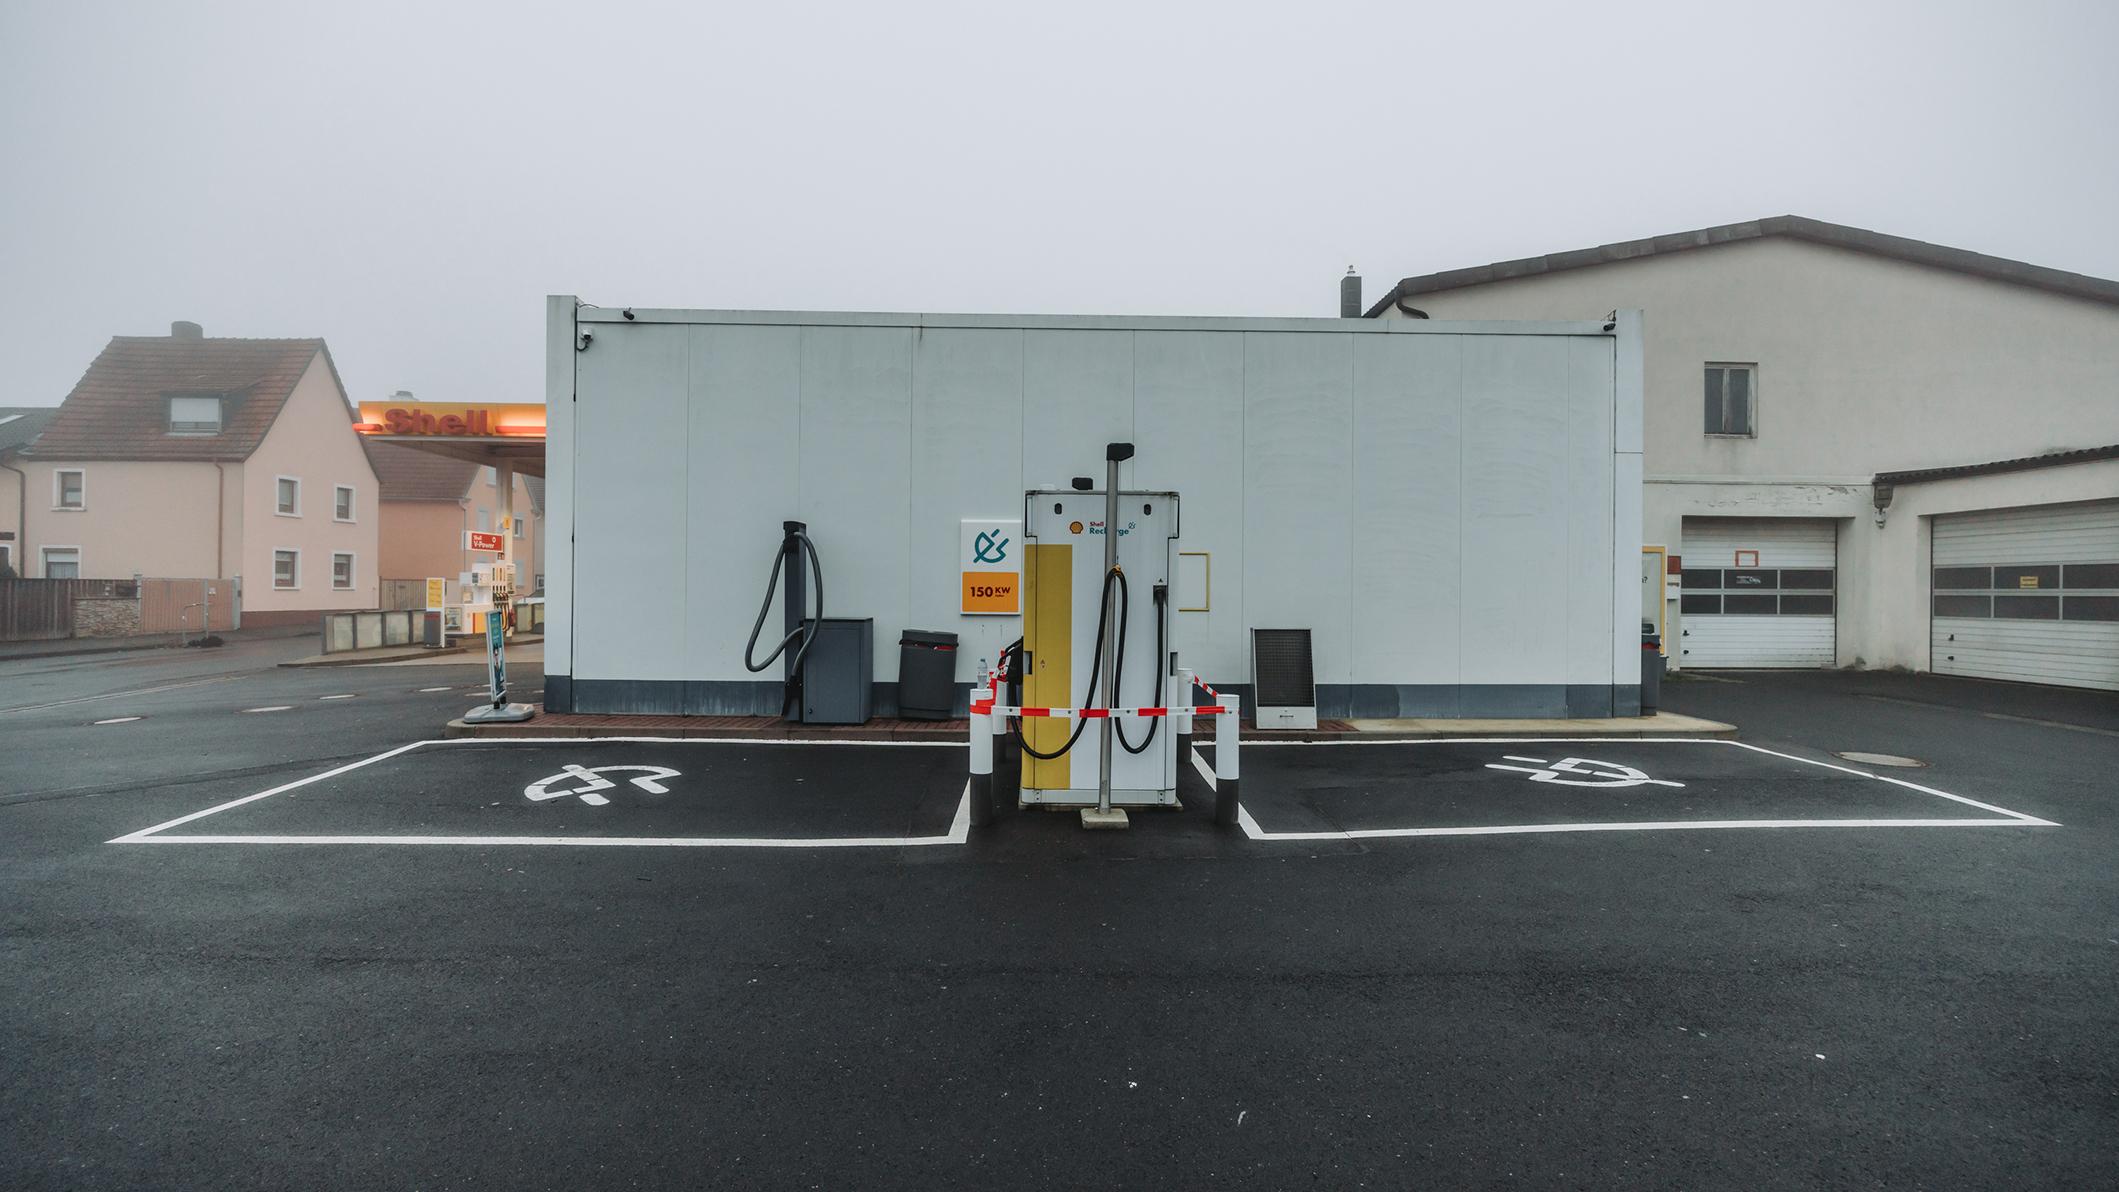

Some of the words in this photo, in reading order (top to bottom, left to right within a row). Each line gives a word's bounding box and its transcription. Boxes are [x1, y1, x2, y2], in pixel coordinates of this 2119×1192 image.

[384, 408, 488, 434] Shell
[1089, 526, 1129, 536] Recge
[473, 540, 495, 549] V-Power
[970, 586, 994, 598] 150
[994, 586, 1011, 594] KW
